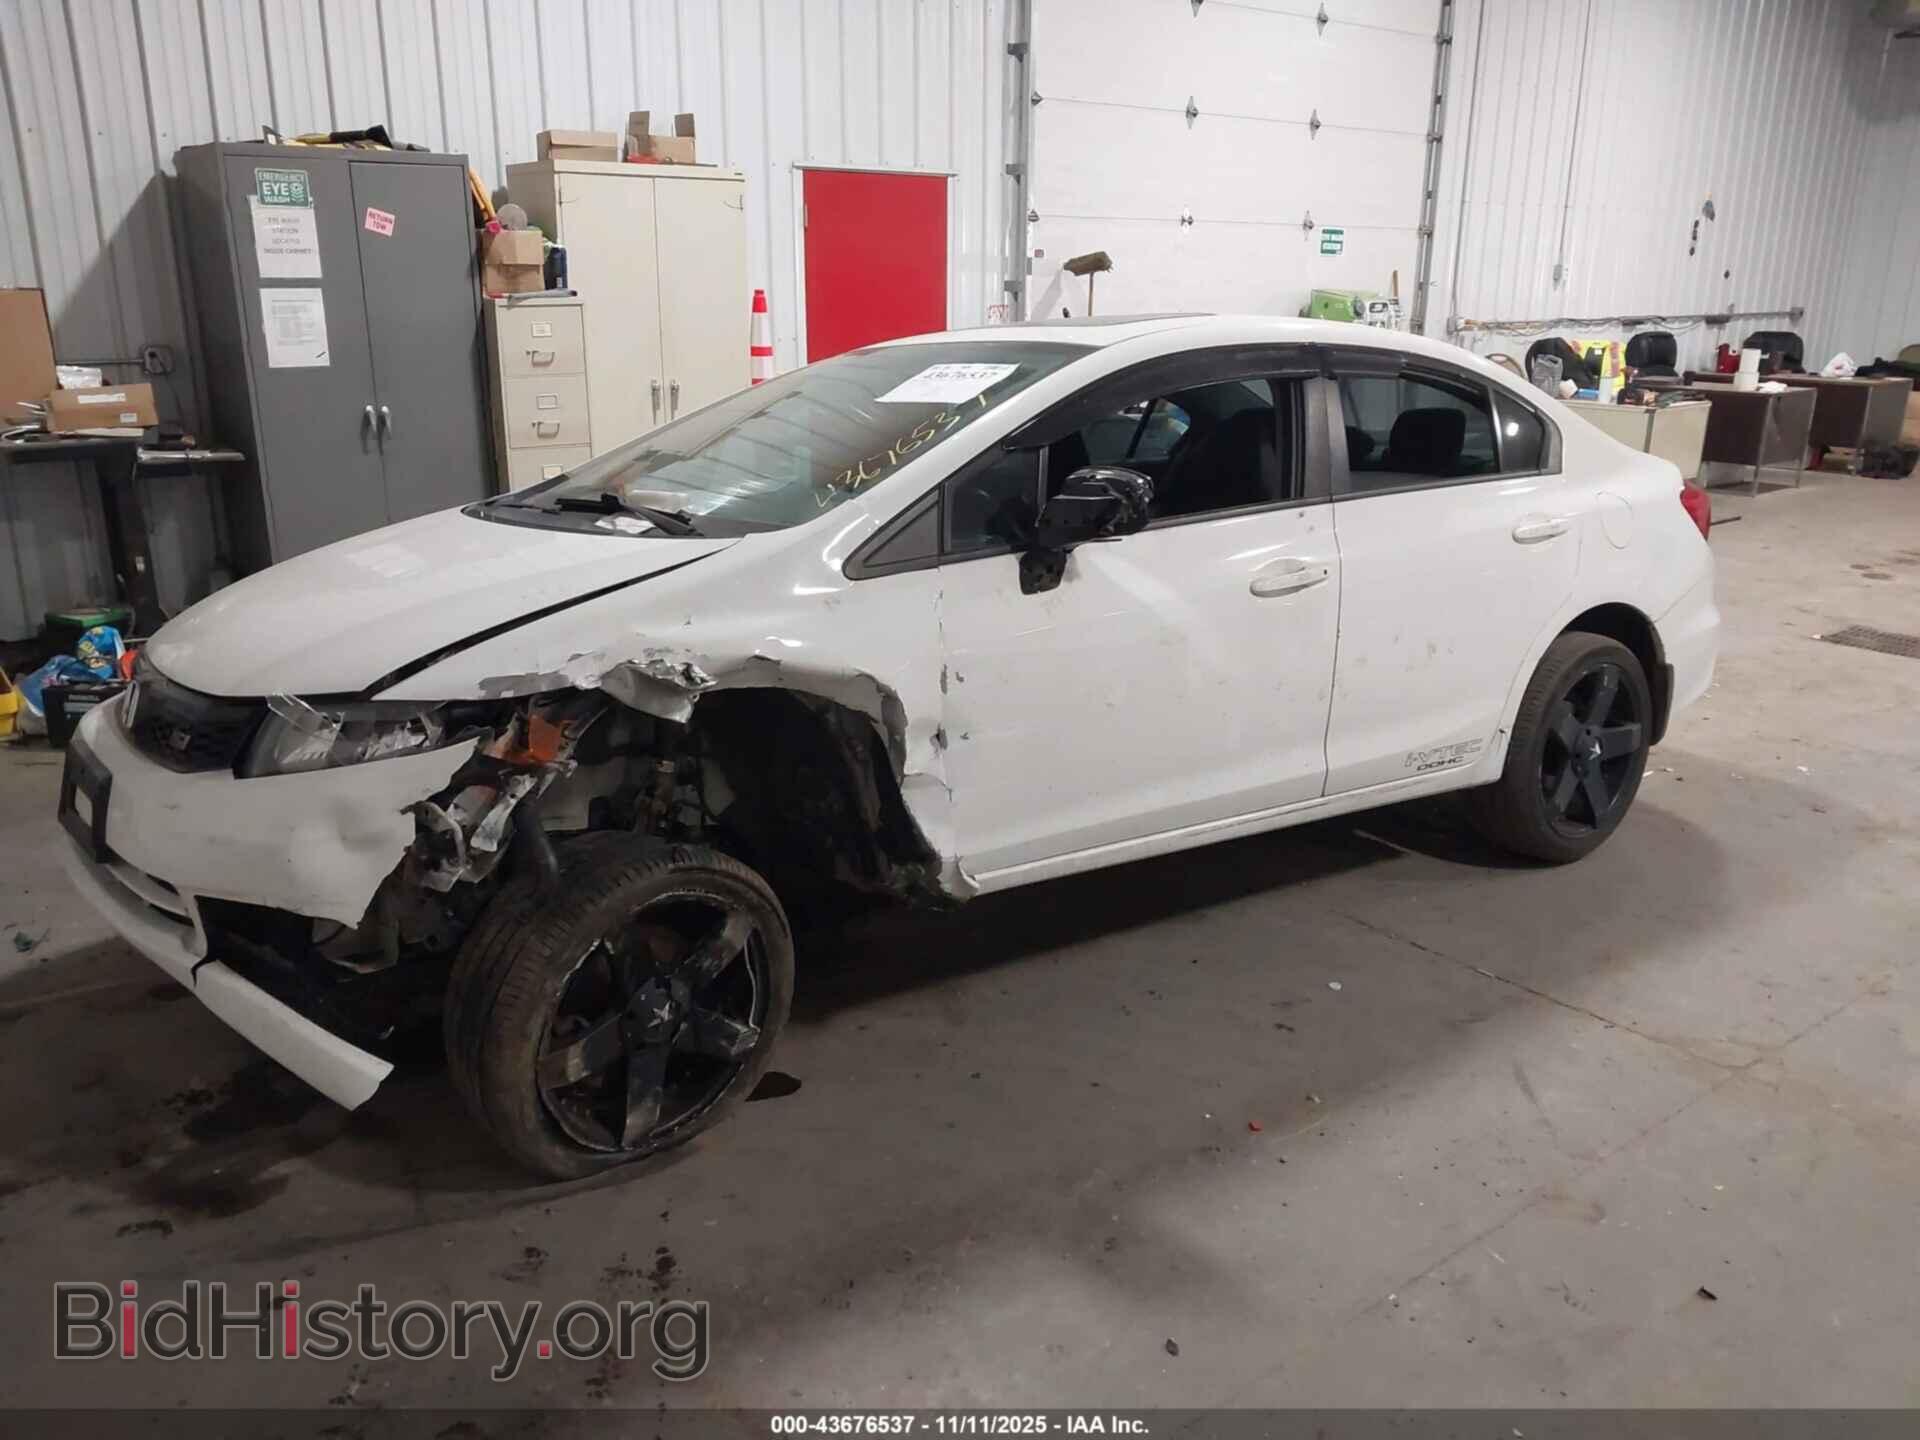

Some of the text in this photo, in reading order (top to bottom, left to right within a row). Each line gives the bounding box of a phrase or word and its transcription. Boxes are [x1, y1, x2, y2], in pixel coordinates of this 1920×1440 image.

[258, 170, 305, 181] EMERGENCY
[262, 182, 289, 196] EYE
[264, 195, 290, 204] WASH
[368, 210, 393, 225] RETURN
[372, 219, 387, 230] TOW
[1416, 755, 1465, 772] DOHC
